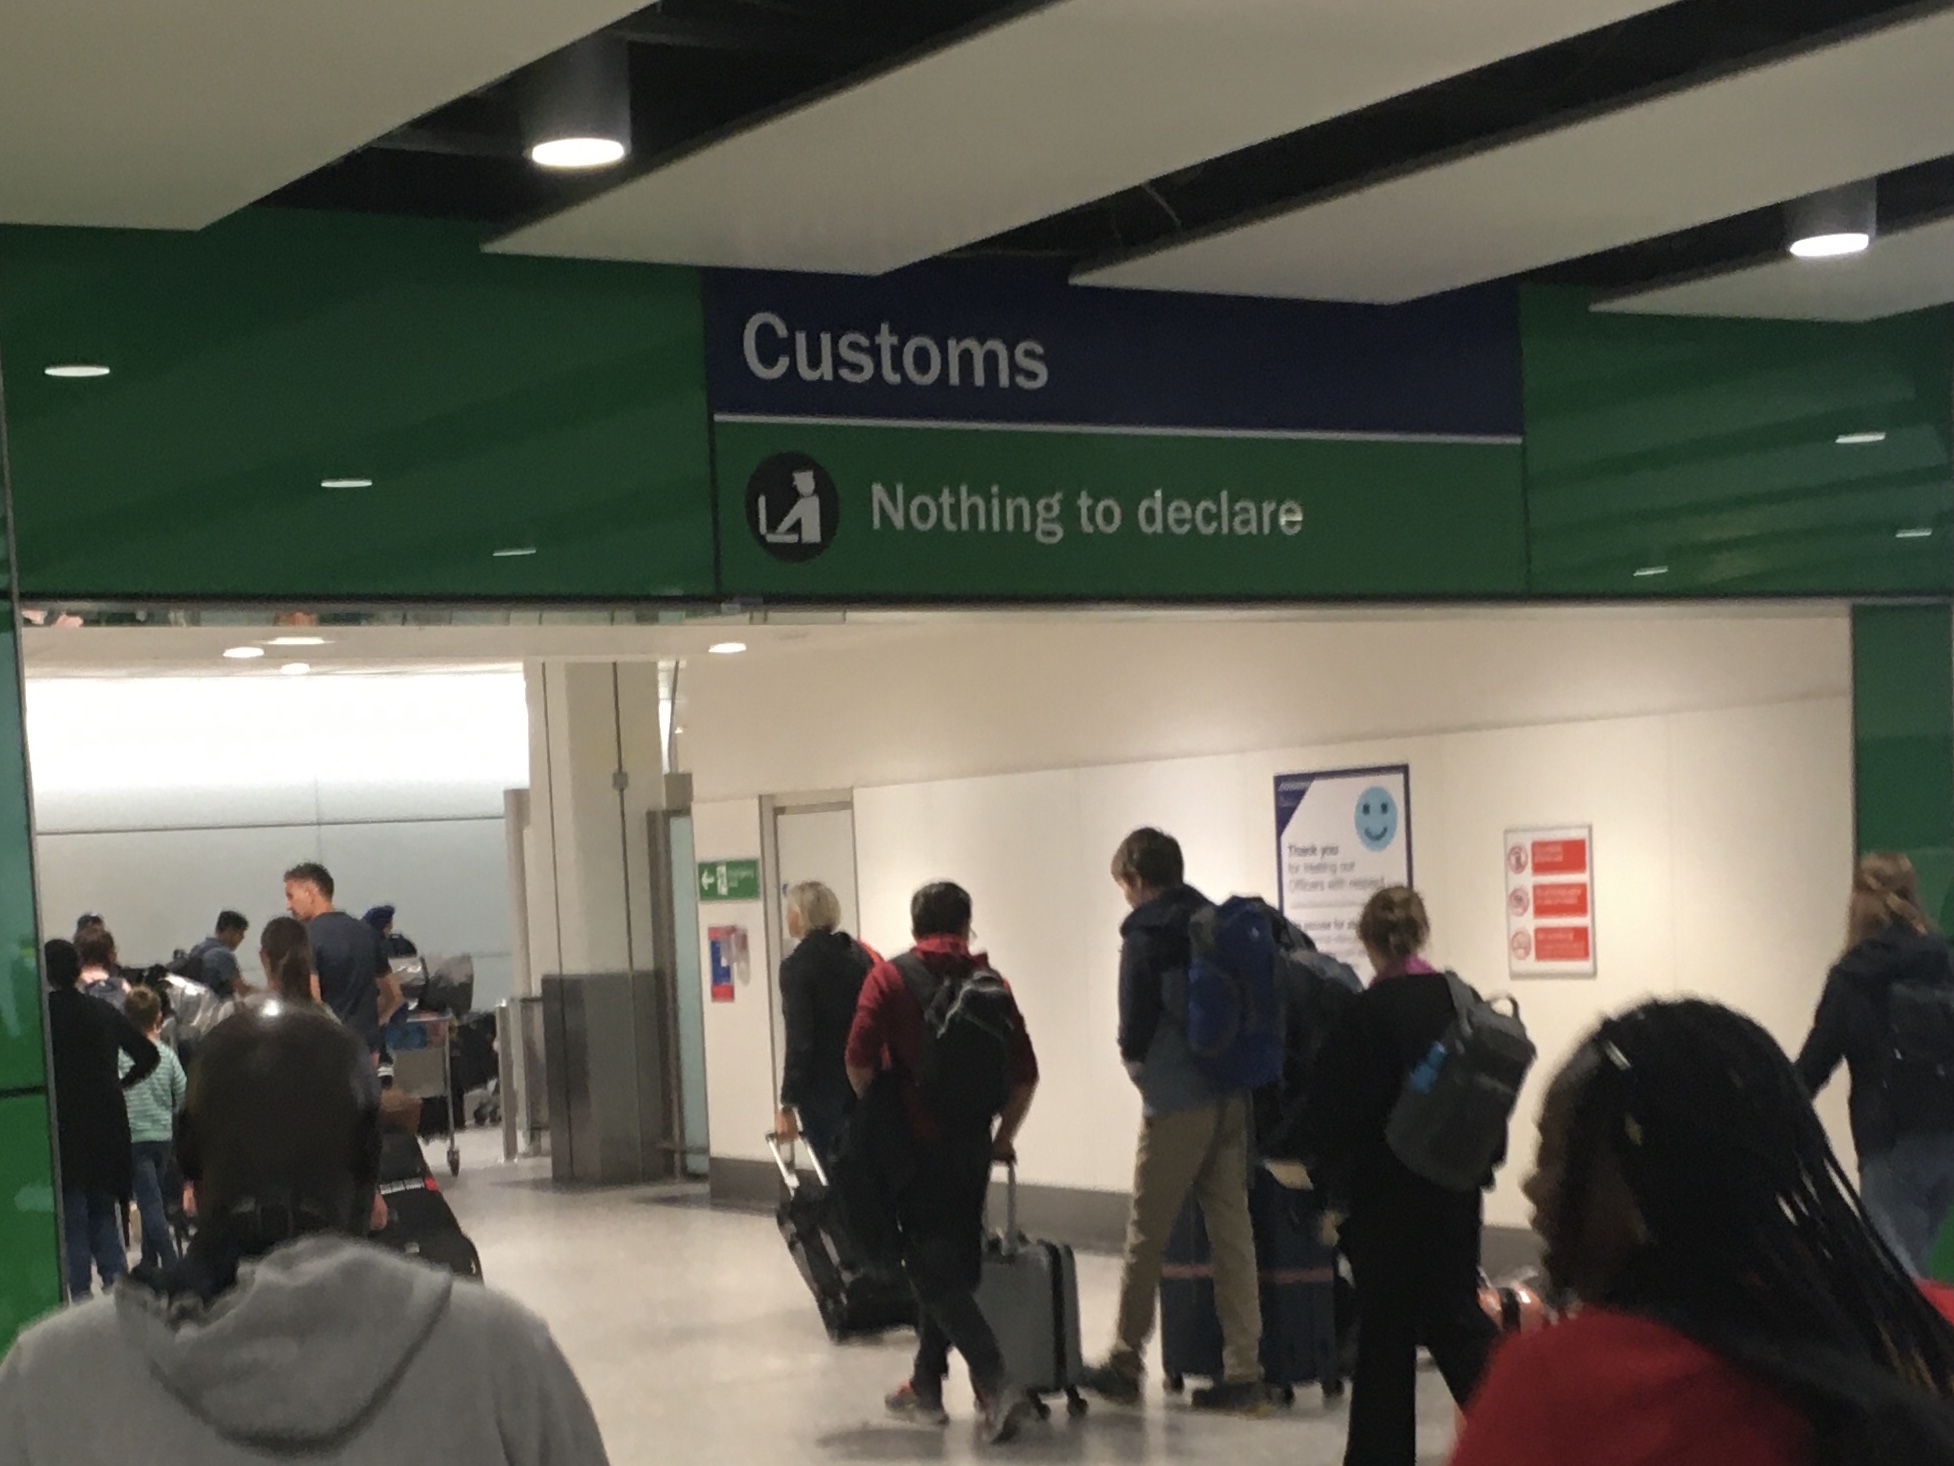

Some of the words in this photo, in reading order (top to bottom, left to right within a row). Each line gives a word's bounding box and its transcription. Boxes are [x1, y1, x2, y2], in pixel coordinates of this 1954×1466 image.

[743, 311, 1048, 390] Customs
[871, 482, 1064, 544] Nothing
[1077, 489, 1122, 533] to
[1138, 488, 1304, 536] declare
